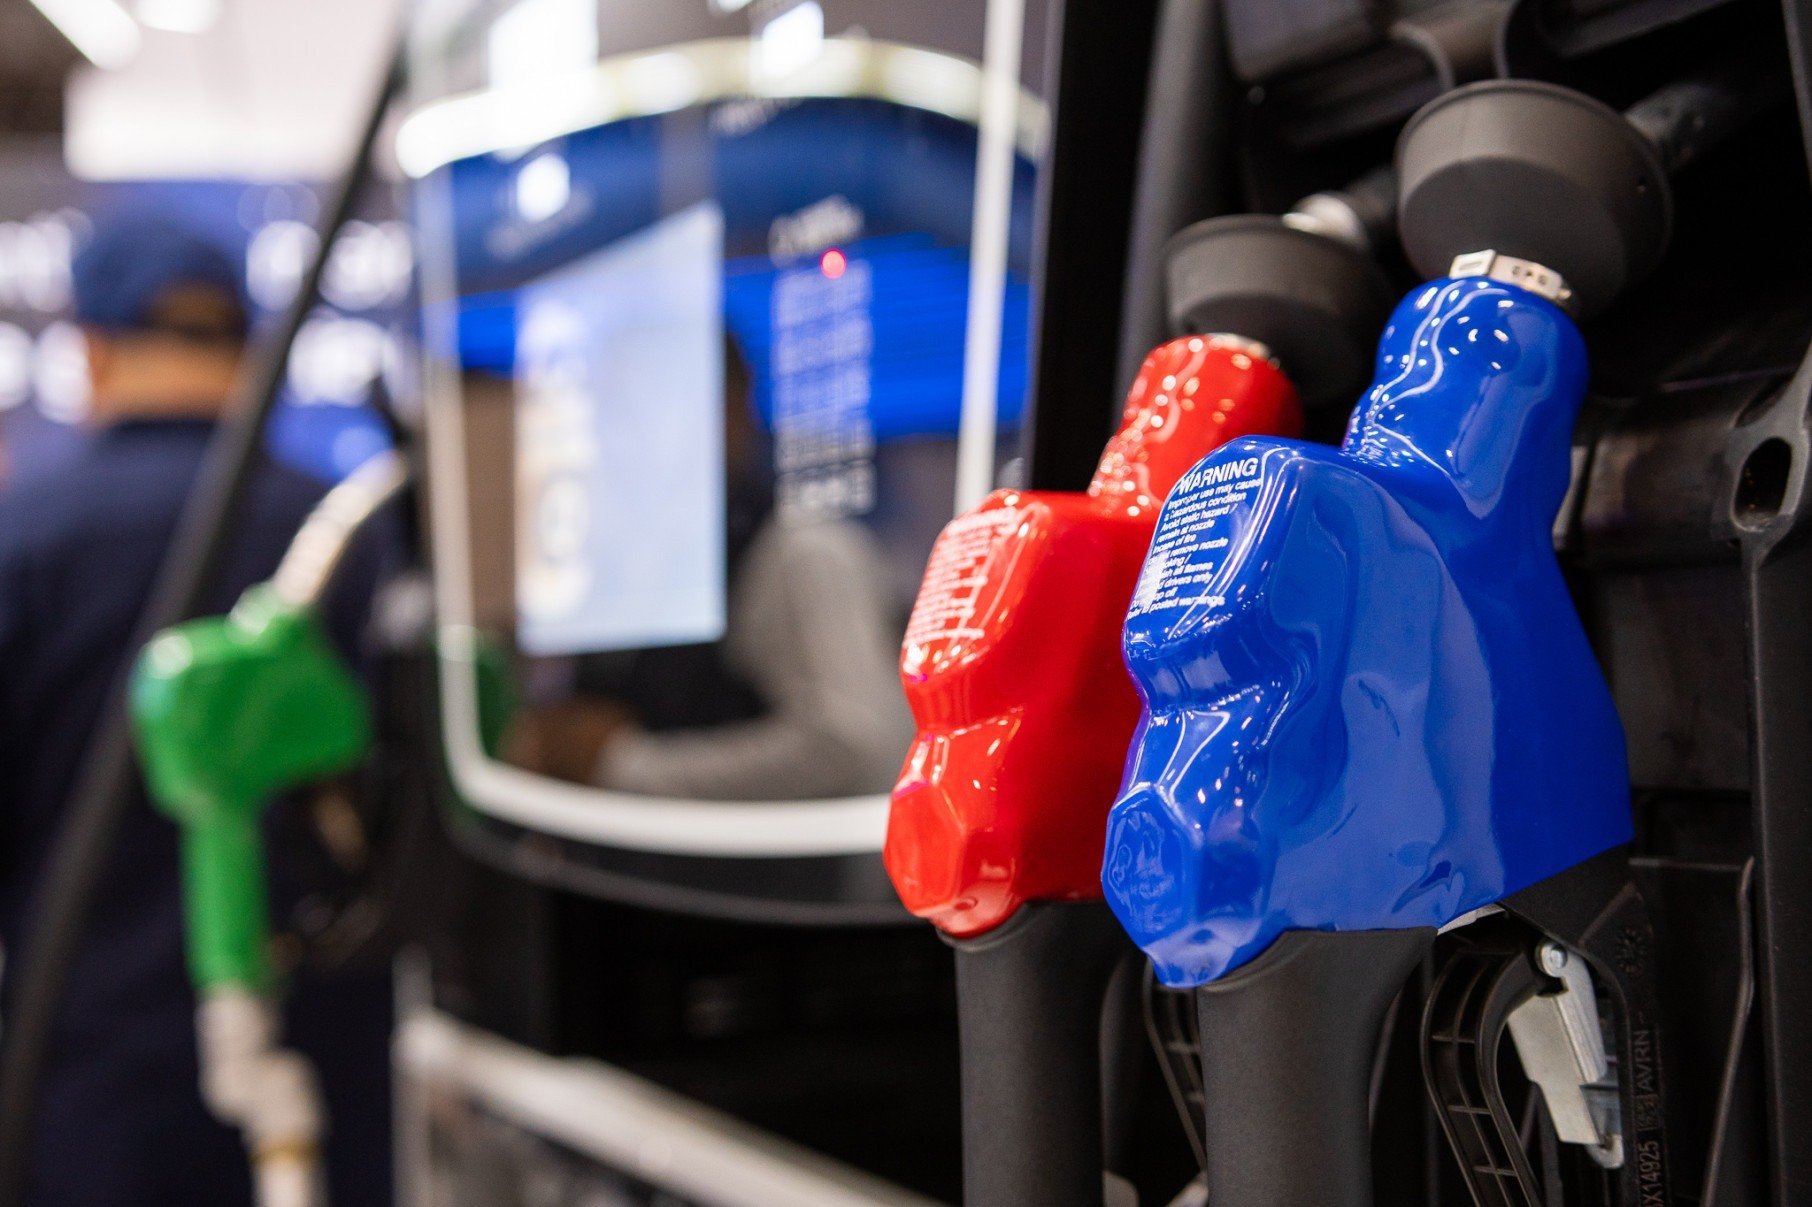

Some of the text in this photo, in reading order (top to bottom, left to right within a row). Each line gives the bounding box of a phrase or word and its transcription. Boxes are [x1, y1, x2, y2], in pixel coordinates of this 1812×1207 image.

[1179, 457, 1259, 496] WARNING
[1167, 492, 1200, 510] Improper
[1200, 488, 1215, 499] use
[1215, 484, 1235, 494] may
[1208, 493, 1247, 507] condition
[1160, 518, 1181, 532] Avoid
[1180, 511, 1201, 525] static
[1200, 505, 1231, 519] hazard
[1156, 520, 1216, 543] remain at nozzle
[1175, 535, 1186, 546] of
[1183, 534, 1197, 544] fire
[1169, 537, 1229, 557] remove nozzle
[1173, 565, 1186, 576] all
[1183, 562, 1214, 573] flames
[1164, 576, 1193, 588] drivers
[1192, 572, 1214, 584] only
[1164, 587, 1179, 598] off
[1148, 596, 1180, 614] posted
[1633, 1030, 1654, 1092] AVRN
